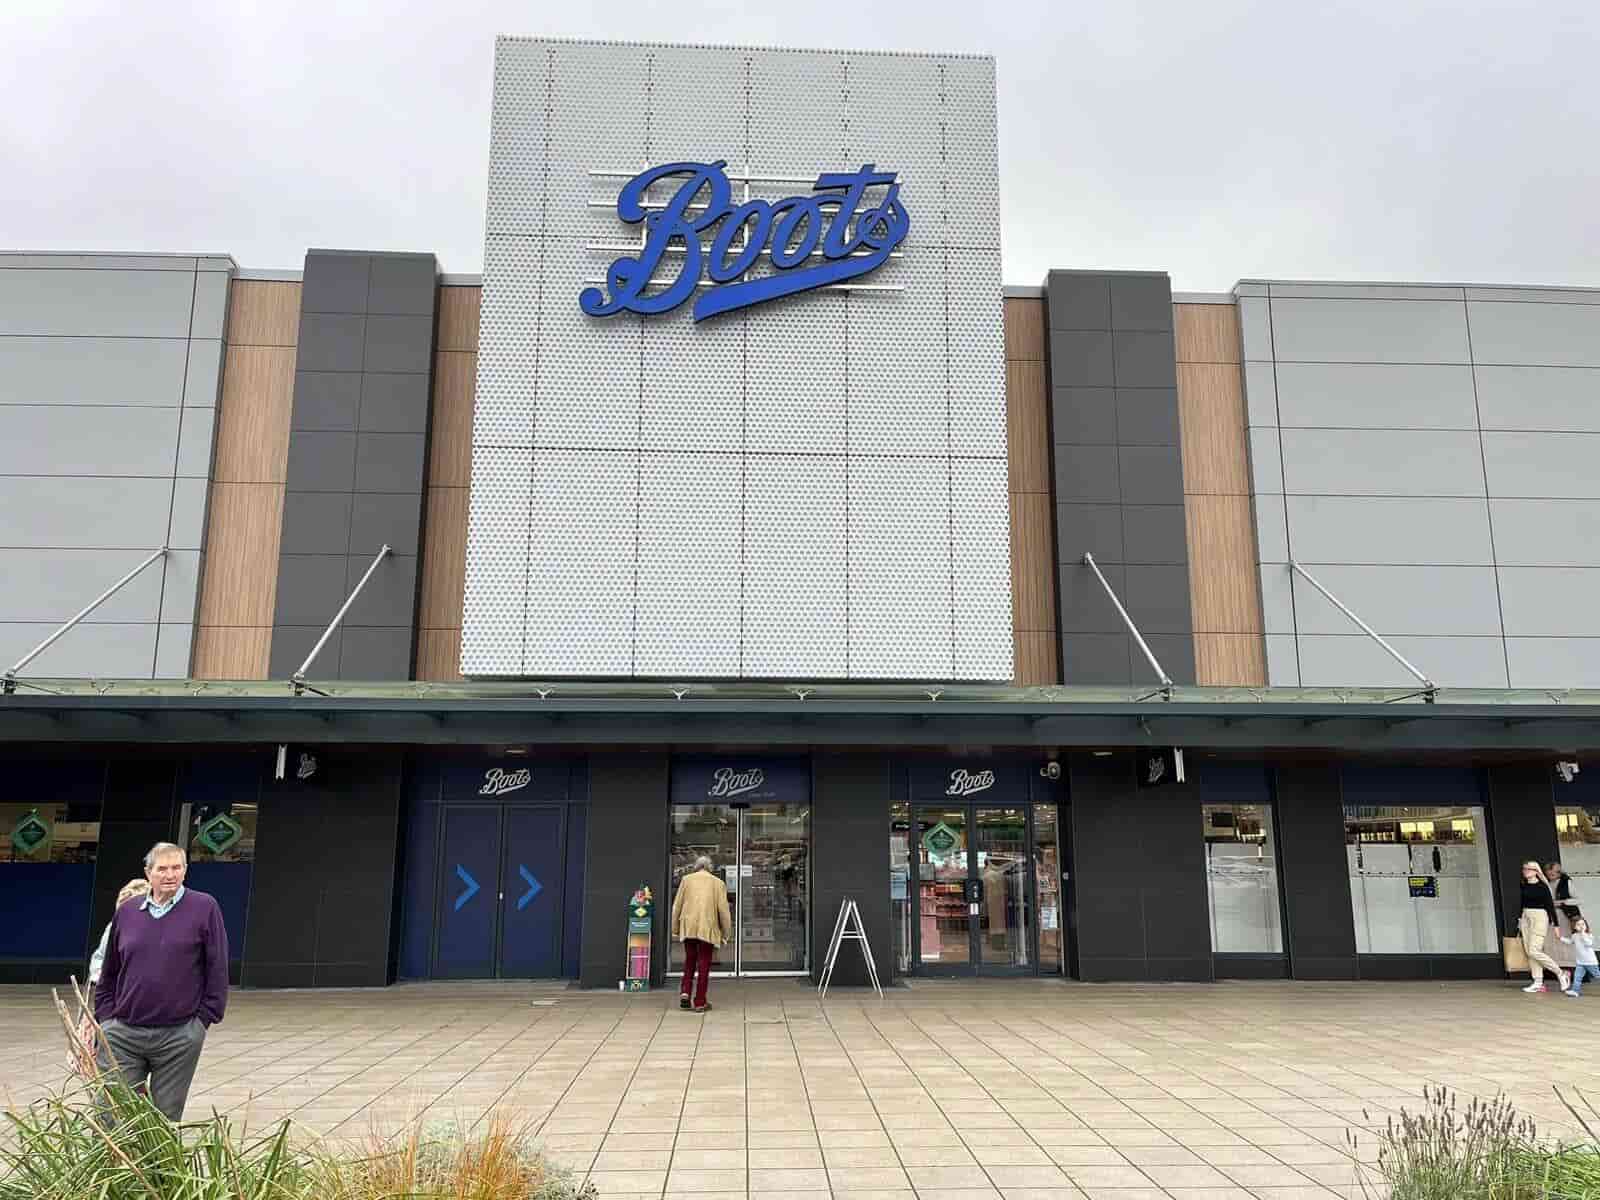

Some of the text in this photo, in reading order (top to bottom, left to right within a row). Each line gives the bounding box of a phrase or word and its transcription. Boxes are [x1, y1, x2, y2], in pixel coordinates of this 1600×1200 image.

[579, 160, 910, 322] Boots
[479, 768, 531, 795] Boots
[708, 768, 764, 797] Boots
[945, 769, 995, 796] Boots
